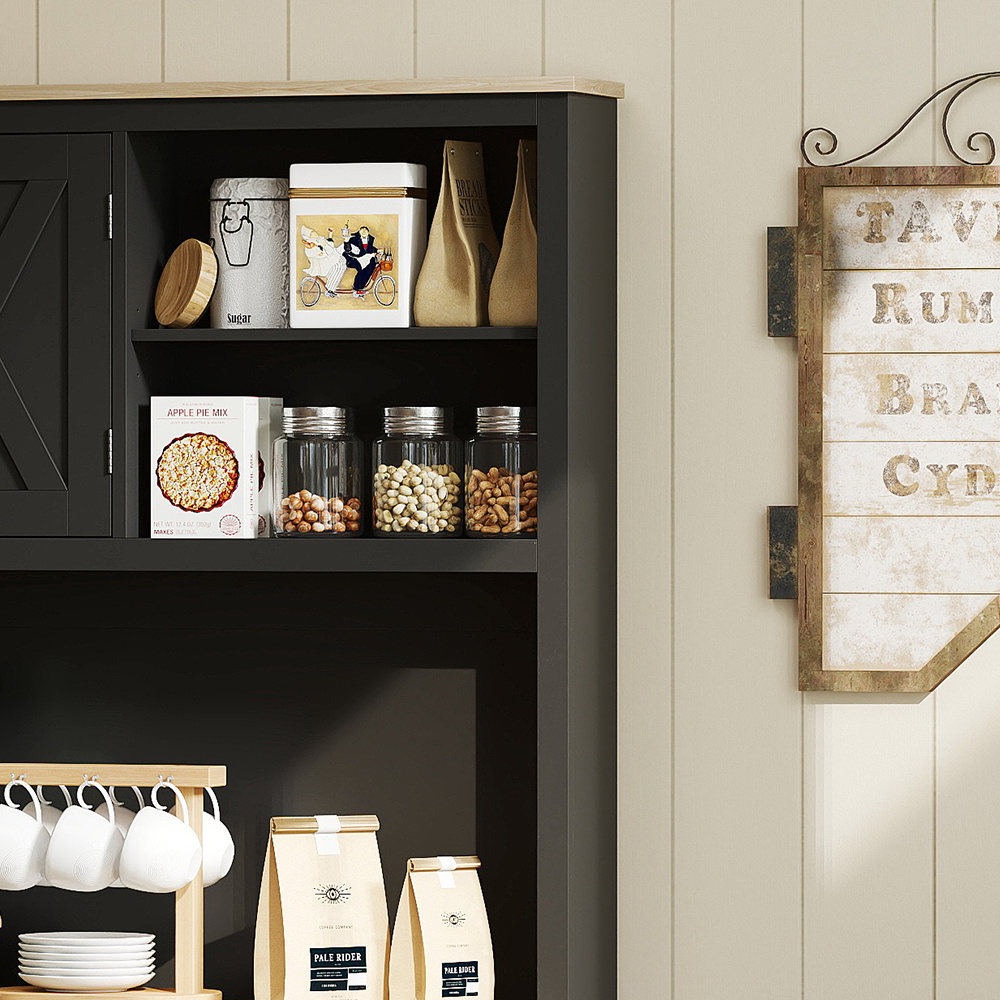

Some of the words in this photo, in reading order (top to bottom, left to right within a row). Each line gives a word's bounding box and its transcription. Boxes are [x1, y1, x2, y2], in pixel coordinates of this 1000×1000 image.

[455, 179, 482, 197] BREAD
[459, 198, 487, 216] STICKS
[856, 200, 1000, 243] TAV
[871, 282, 994, 325] RUM
[227, 313, 252, 325] Sugar
[875, 373, 1000, 415] BRA
[167, 408, 194, 417] APPLE
[196, 408, 210, 417] PIE
[212, 408, 228, 417] MIX
[314, 953, 334, 962] PALE
[336, 952, 362, 962] RIDER
